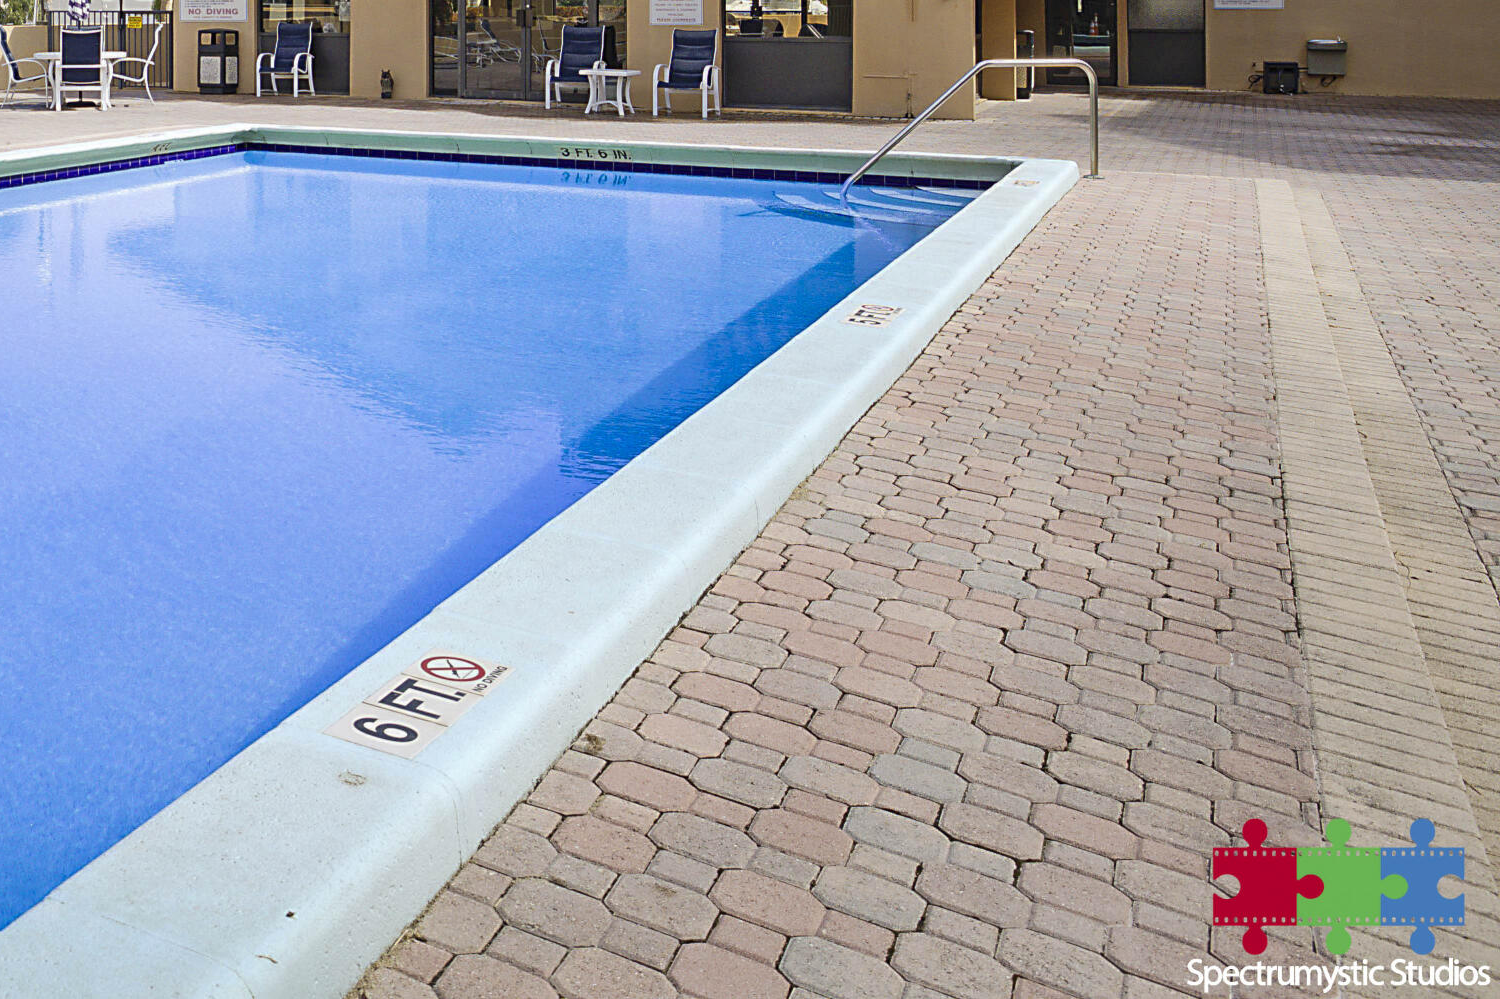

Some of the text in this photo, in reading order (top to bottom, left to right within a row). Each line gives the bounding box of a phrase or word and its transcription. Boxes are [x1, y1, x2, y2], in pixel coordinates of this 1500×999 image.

[560, 147, 632, 160] 3 FT. 6 IN.
[471, 665, 508, 692] NO DIVING
[353, 677, 466, 743] 6 FT.
